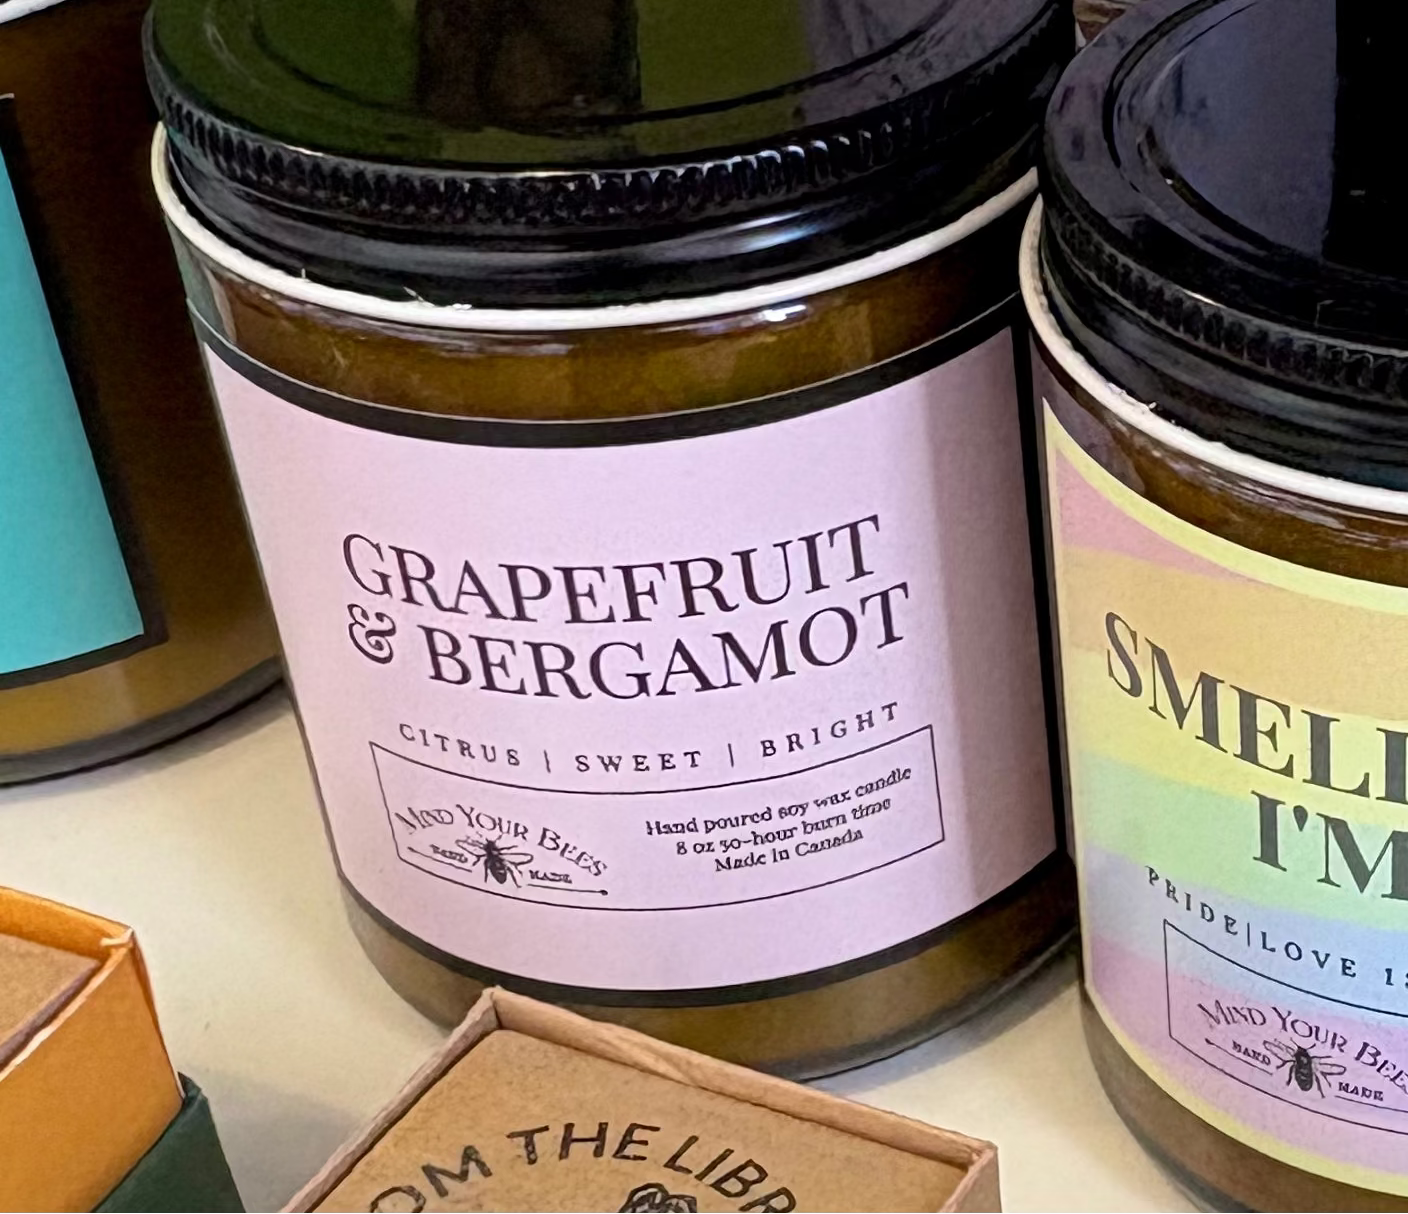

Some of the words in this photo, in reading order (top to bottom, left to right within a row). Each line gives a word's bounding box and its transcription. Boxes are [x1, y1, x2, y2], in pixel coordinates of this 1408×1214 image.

[343, 514, 880, 623] GRAPEFRUIT
[348, 603, 396, 665] &
[417, 582, 909, 700] BERGAMOT
[399, 722, 521, 767] CITRUS
[575, 750, 702, 772] SWEET
[760, 701, 898, 758] BRIGHT
[646, 820, 699, 836] Hand
[704, 806, 773, 834] poured
[778, 801, 810, 820] soy
[855, 767, 911, 798] candle
[676, 841, 688, 855] 8
[802, 814, 847, 835] burn
[455, 803, 528, 841] YOUR
[538, 827, 608, 876] BEES
[715, 851, 767, 872] Made
[795, 828, 864, 857] Canada
[1198, 1000, 1267, 1028] MIND
[1272, 1006, 1348, 1053] YOUR
[507, 1122, 661, 1165] THE
